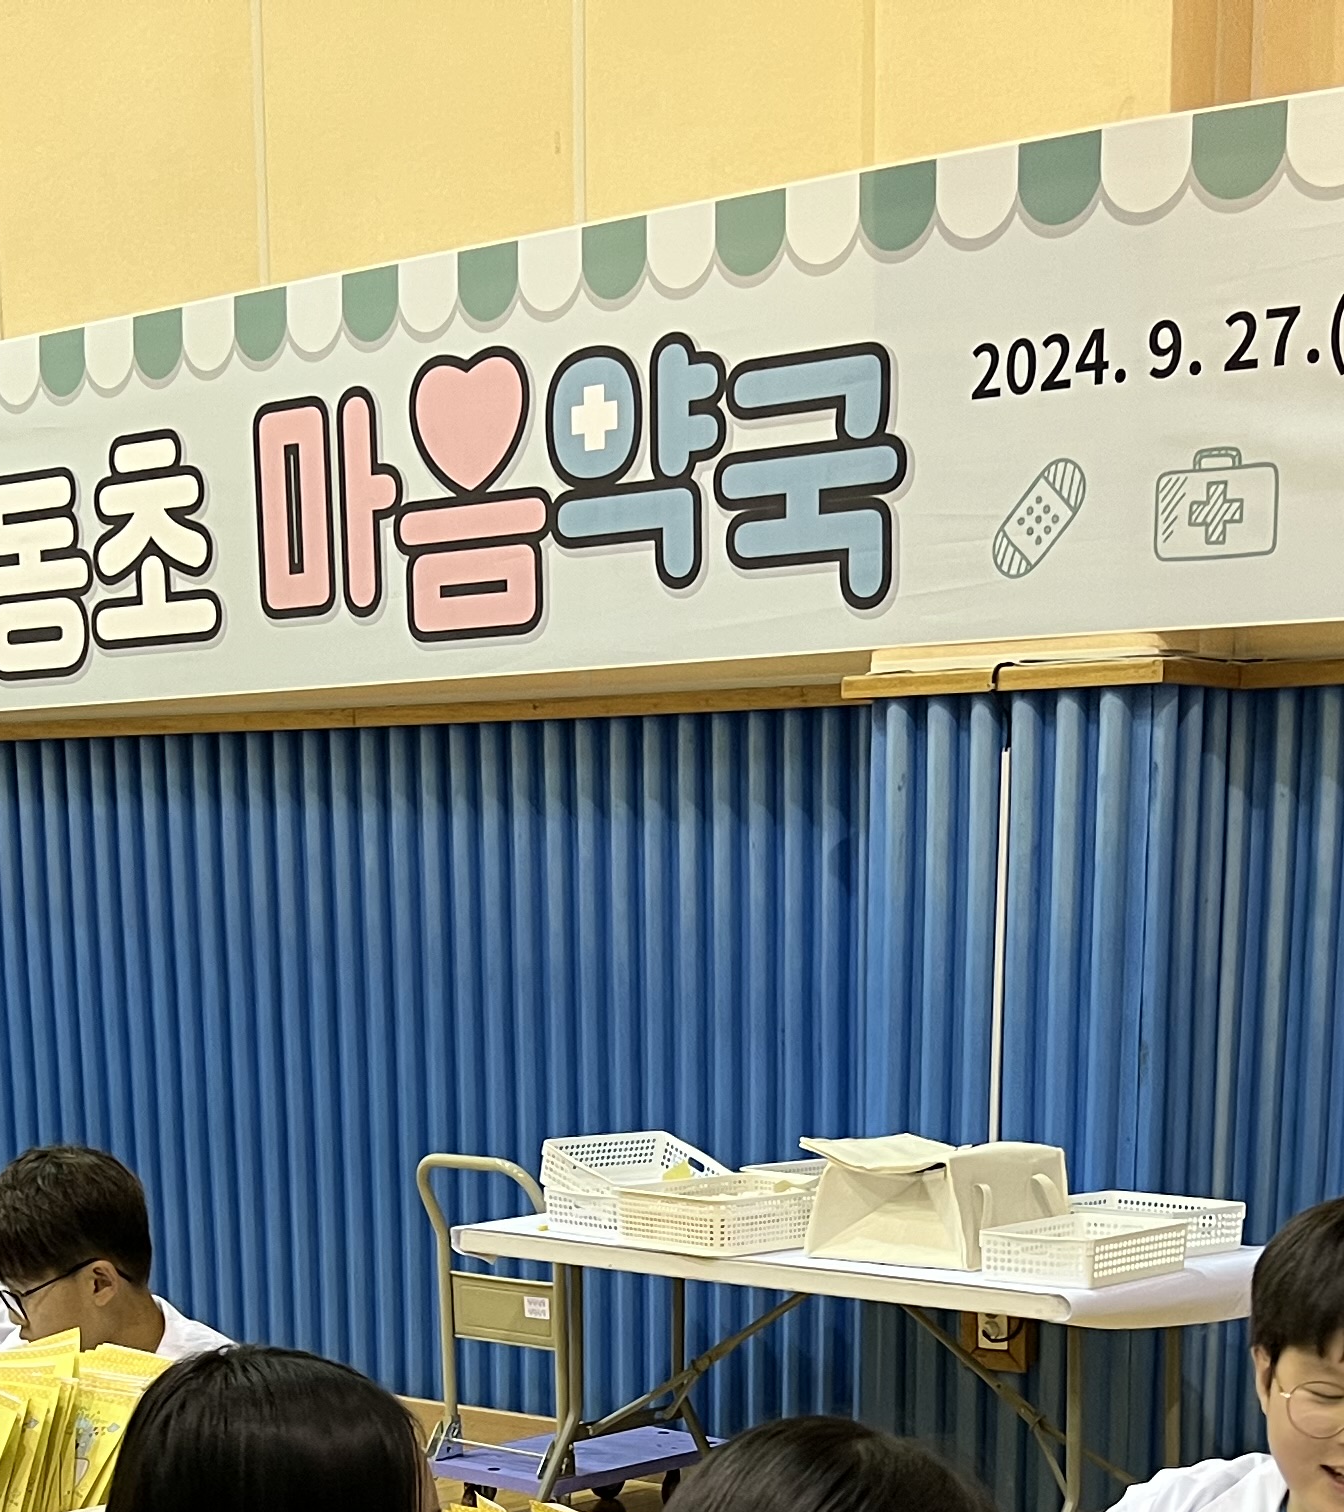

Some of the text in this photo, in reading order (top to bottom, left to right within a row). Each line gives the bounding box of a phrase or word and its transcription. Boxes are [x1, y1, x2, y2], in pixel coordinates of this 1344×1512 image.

[971, 327, 1127, 400] 2024.
[1148, 319, 1202, 379] 9.
[255, 331, 907, 642] 마음약국
